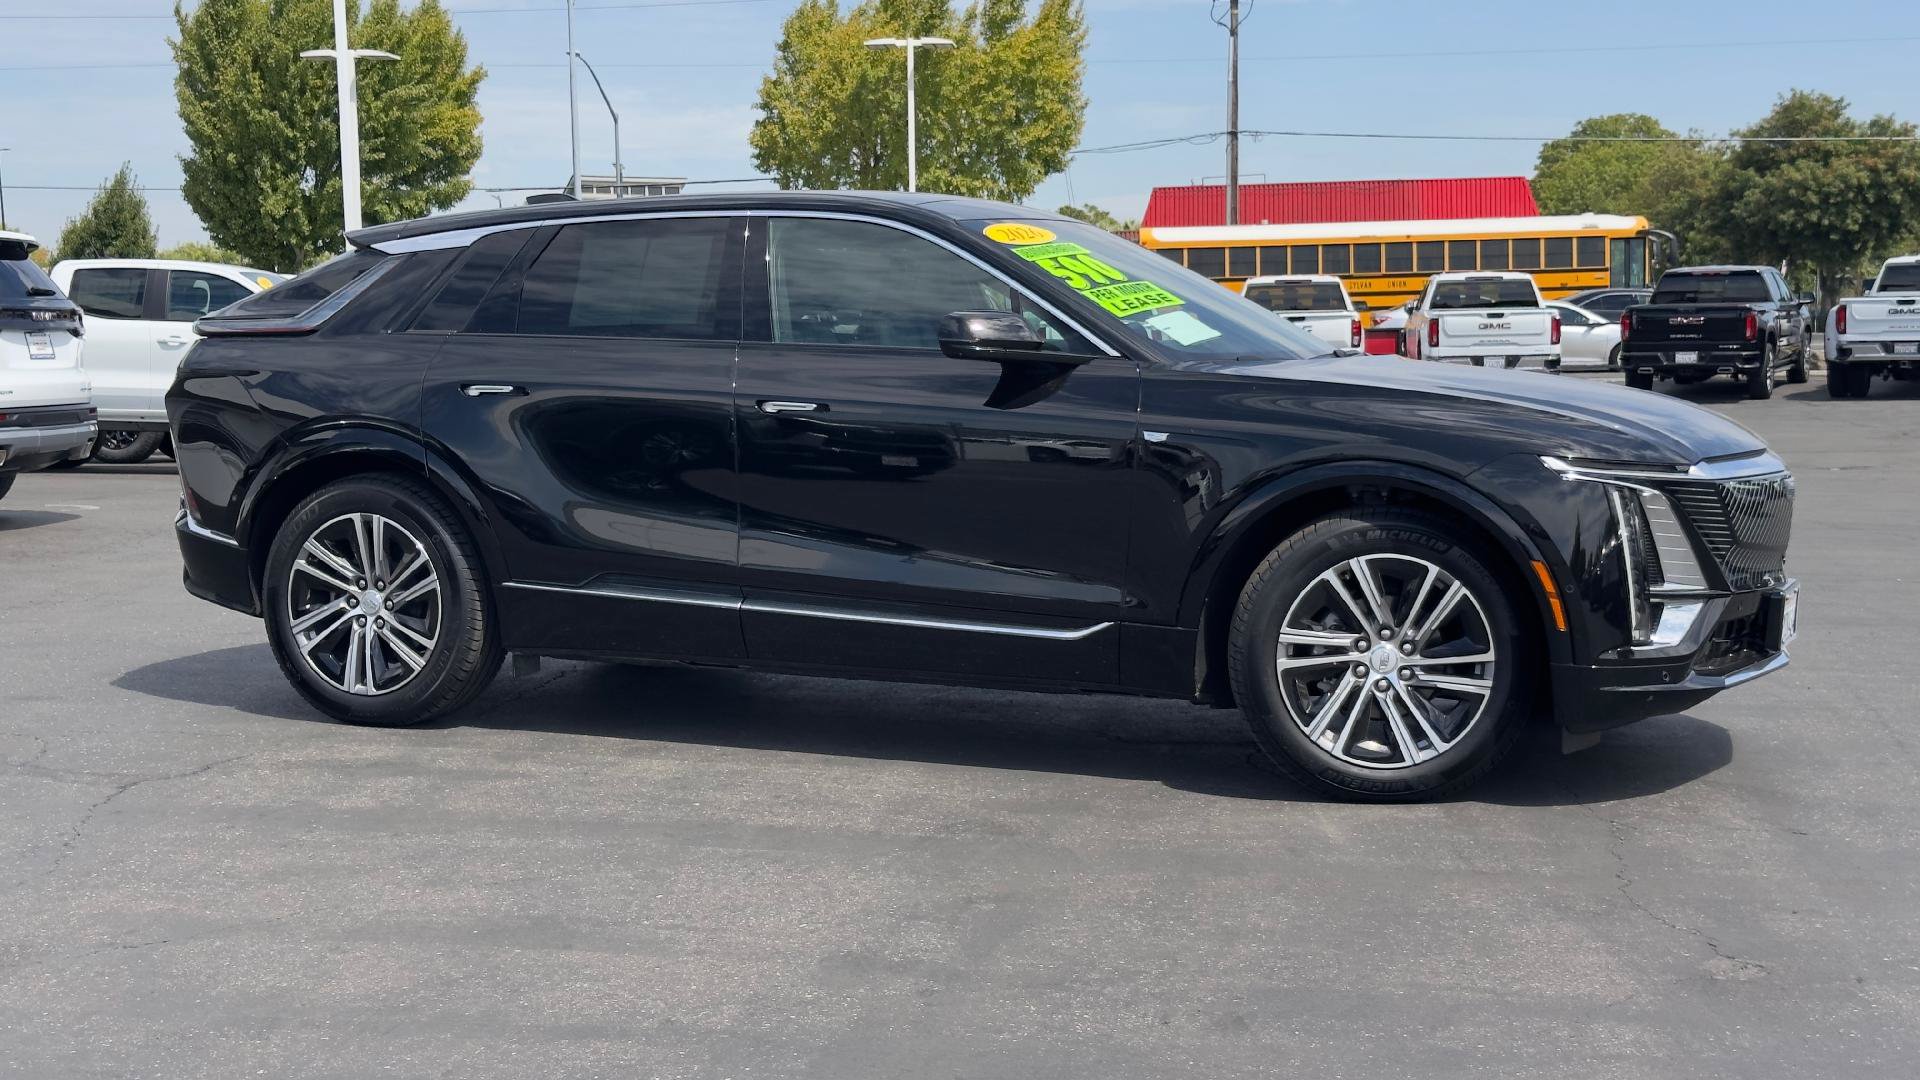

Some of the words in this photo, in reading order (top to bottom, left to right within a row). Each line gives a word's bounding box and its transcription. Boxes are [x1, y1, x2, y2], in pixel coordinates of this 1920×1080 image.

[1090, 289, 1119, 301] PER
[1111, 293, 1173, 311] LEASE
[1669, 317, 1705, 325] GMC
[1366, 529, 1450, 553] MICHELIN
